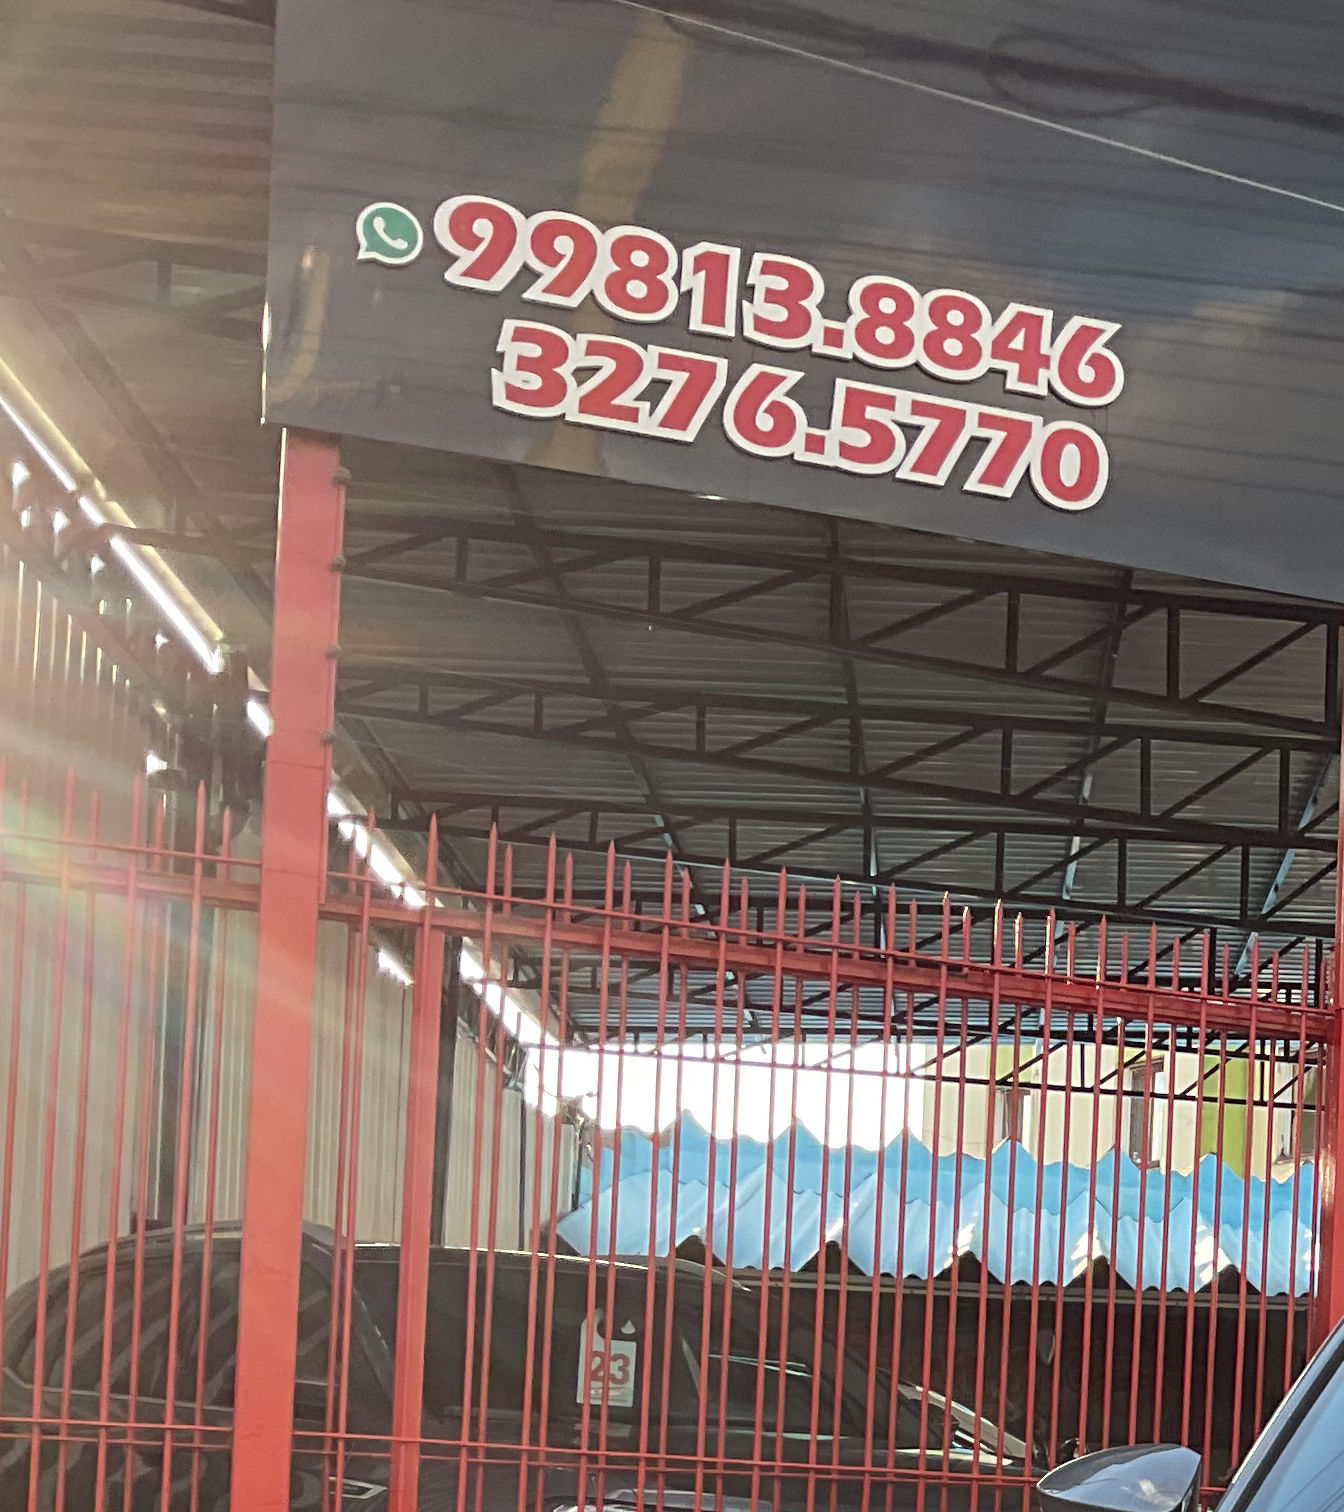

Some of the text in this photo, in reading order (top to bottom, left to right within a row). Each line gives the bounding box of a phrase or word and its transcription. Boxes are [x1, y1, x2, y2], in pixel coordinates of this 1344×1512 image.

[434, 194, 1124, 407] 99813.8846
[491, 319, 1110, 511] 3276.5770
[590, 1350, 631, 1386] 23
